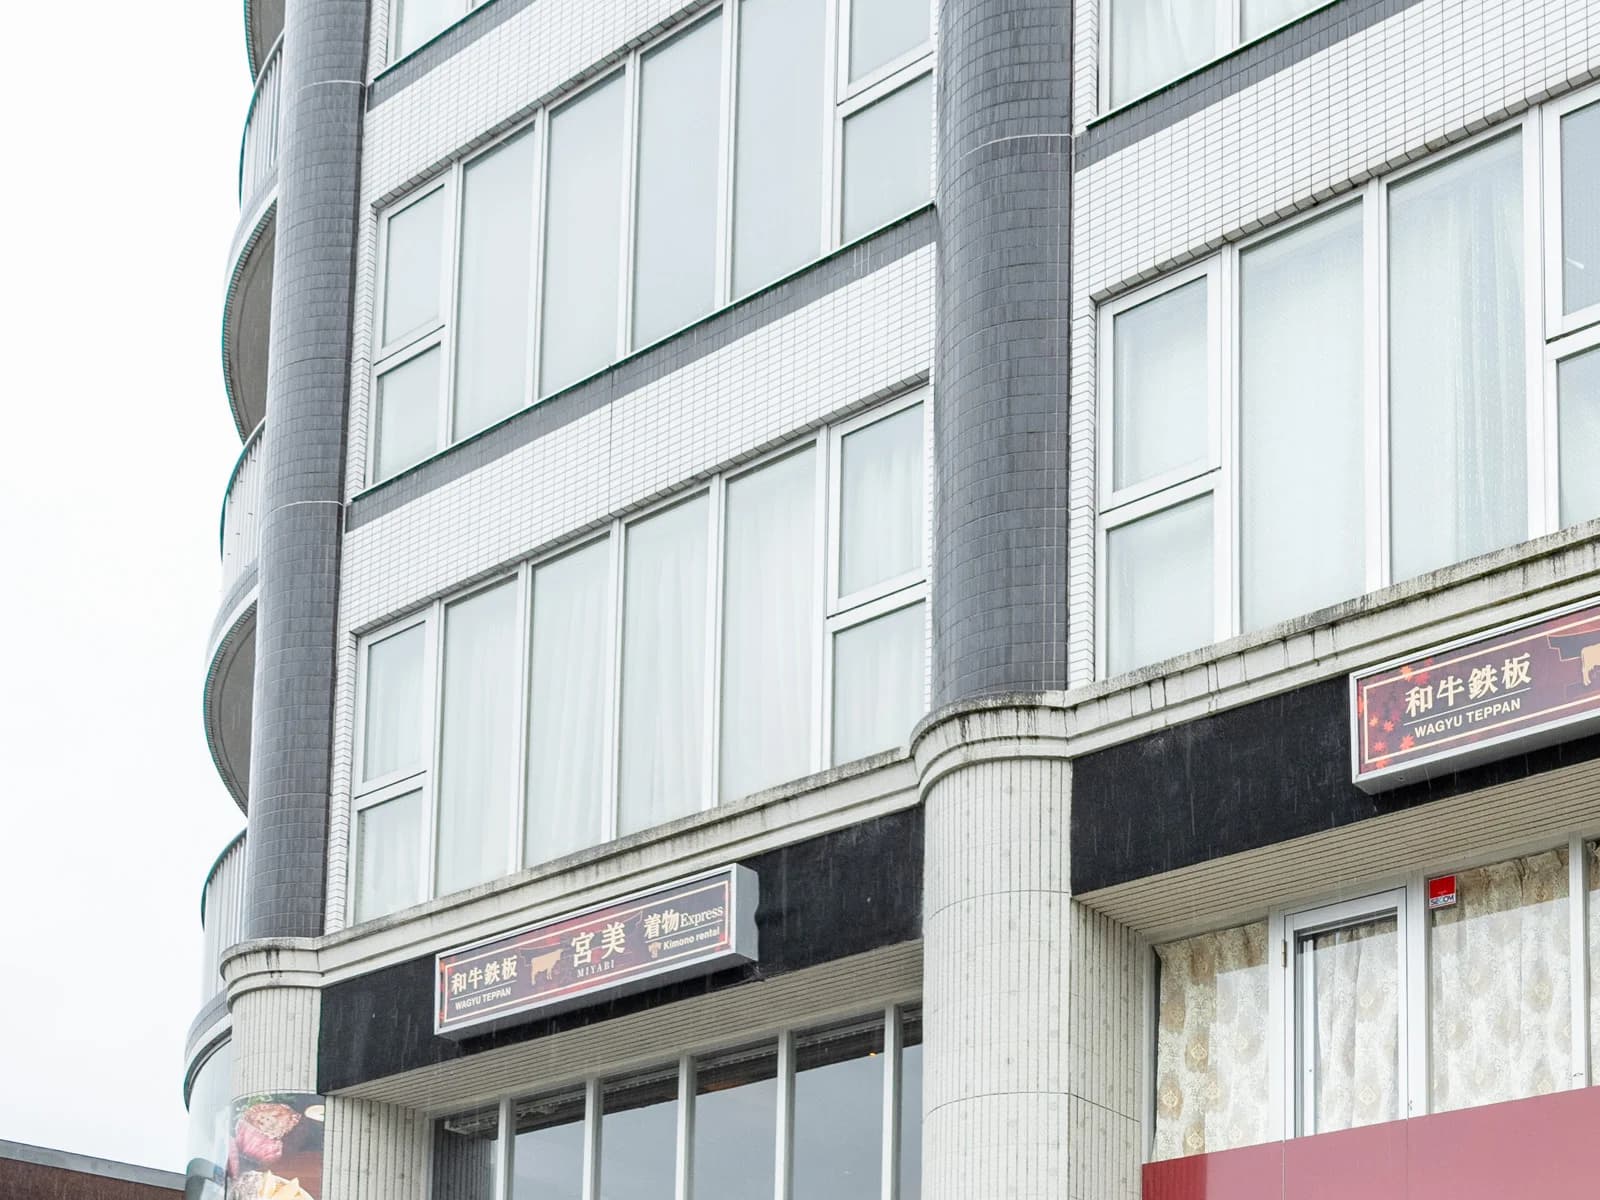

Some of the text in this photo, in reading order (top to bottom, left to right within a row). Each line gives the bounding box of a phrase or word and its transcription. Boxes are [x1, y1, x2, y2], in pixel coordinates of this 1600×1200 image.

[1405, 651, 1532, 717] 和牛鉄板
[1414, 698, 1521, 738] WAGYU TEPPAN
[571, 922, 626, 968] 宮美
[663, 927, 720, 950] Kimono rental
[450, 954, 518, 995] 和牛鉄板
[576, 960, 615, 978] MIYABI
[455, 987, 512, 1012] WAGYU TEPPAN
